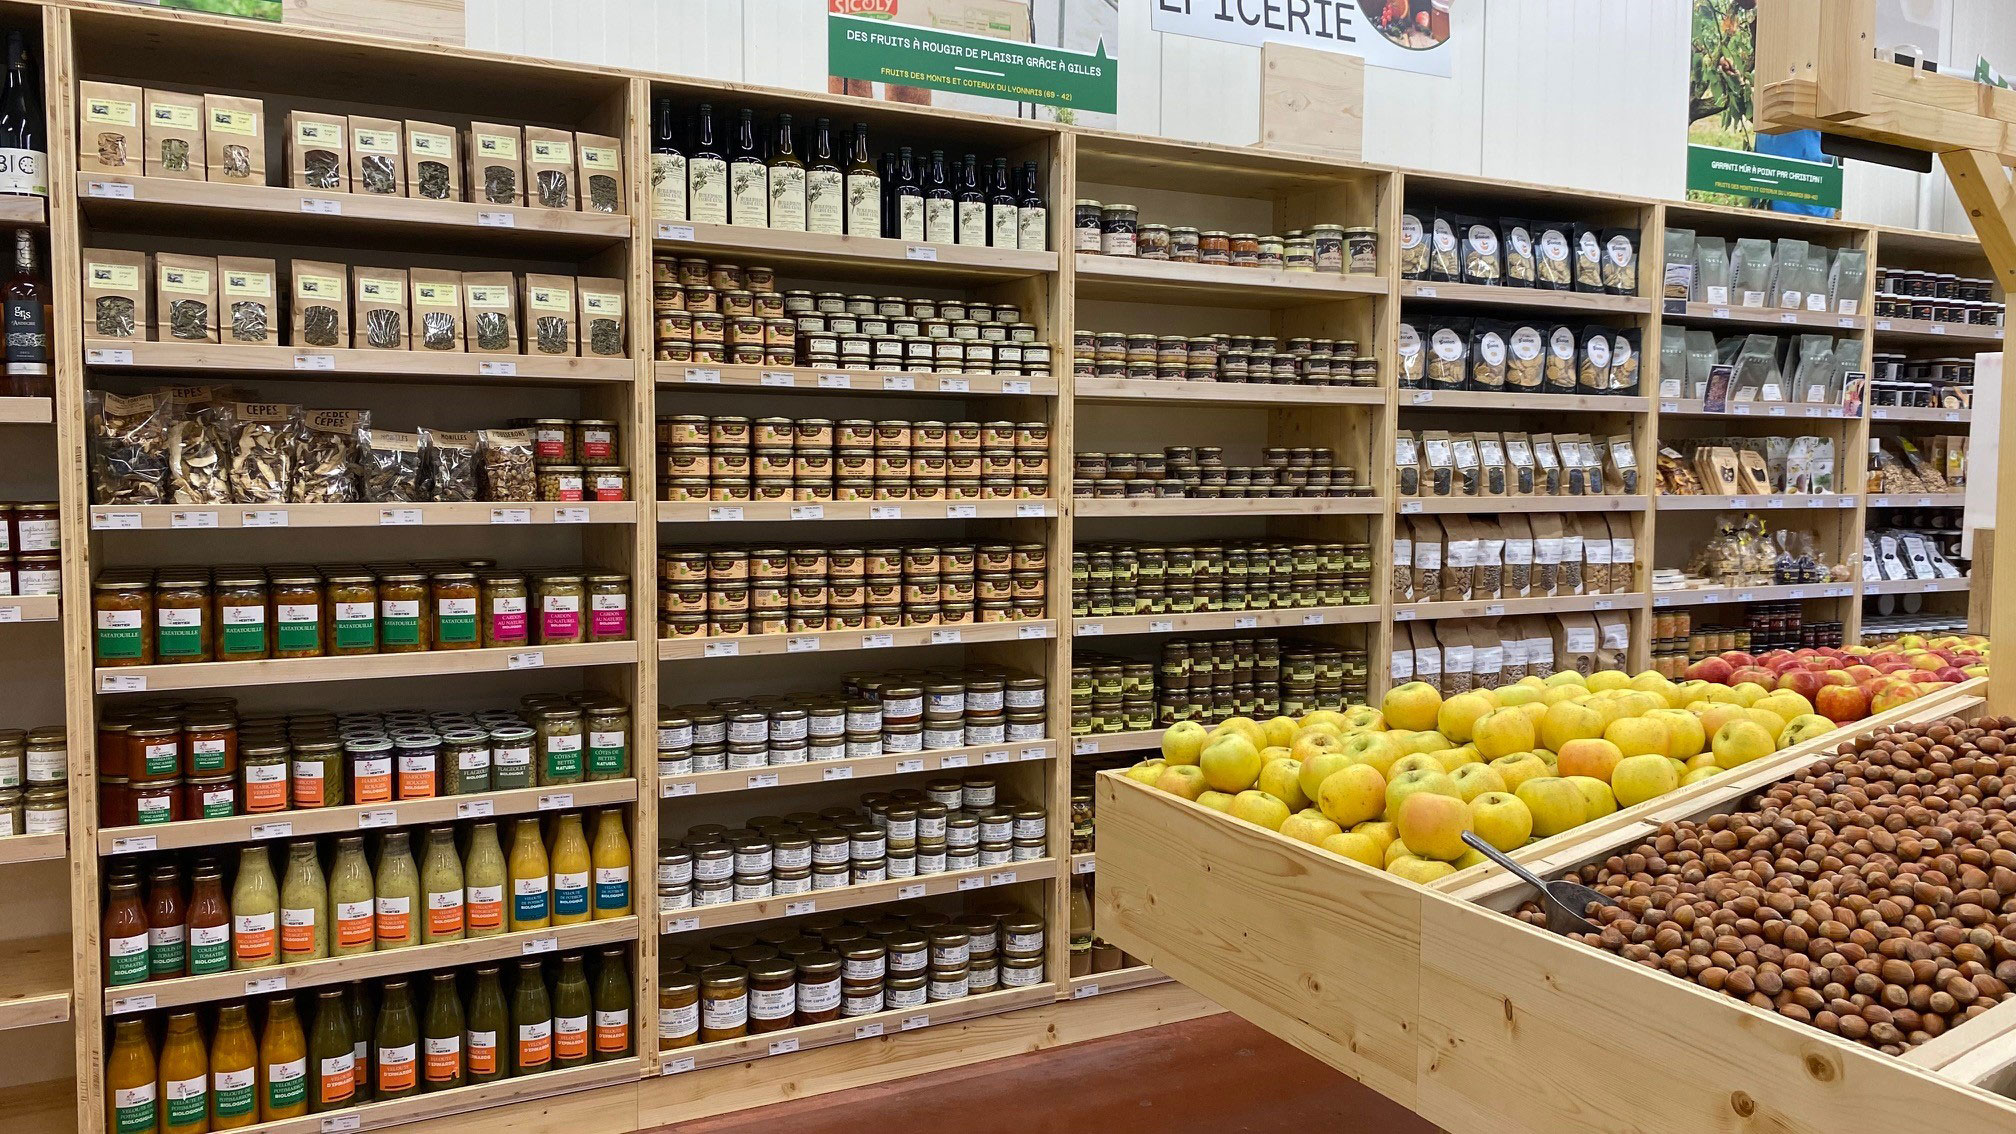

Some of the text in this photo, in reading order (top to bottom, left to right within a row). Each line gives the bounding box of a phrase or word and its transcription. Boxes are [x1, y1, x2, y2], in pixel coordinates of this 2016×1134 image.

[847, 29, 1102, 77] DES FRUITS À ROUGIR DE PLAISIR GRÂCE À GILLES
[880, 67, 909, 78] FRUITS
[910, 71, 925, 80] DES
[926, 74, 951, 84] MONTS
[952, 77, 961, 85] ET
[963, 79, 995, 90] COTEAUX
[996, 83, 1007, 92] DU
[1008, 85, 1043, 97] LYONNAIS
[1043, 89, 1056, 99] (69
[1061, 92, 1073, 102] 42)
[1711, 160, 1738, 172] GARANTI
[1757, 168, 1776, 177] POINT
[1776, 170, 1788, 178] PAR
[1789, 171, 1819, 183] CHRISTIAN
[14, 306, 31, 320] gris
[440, 433, 467, 441] MORILLES
